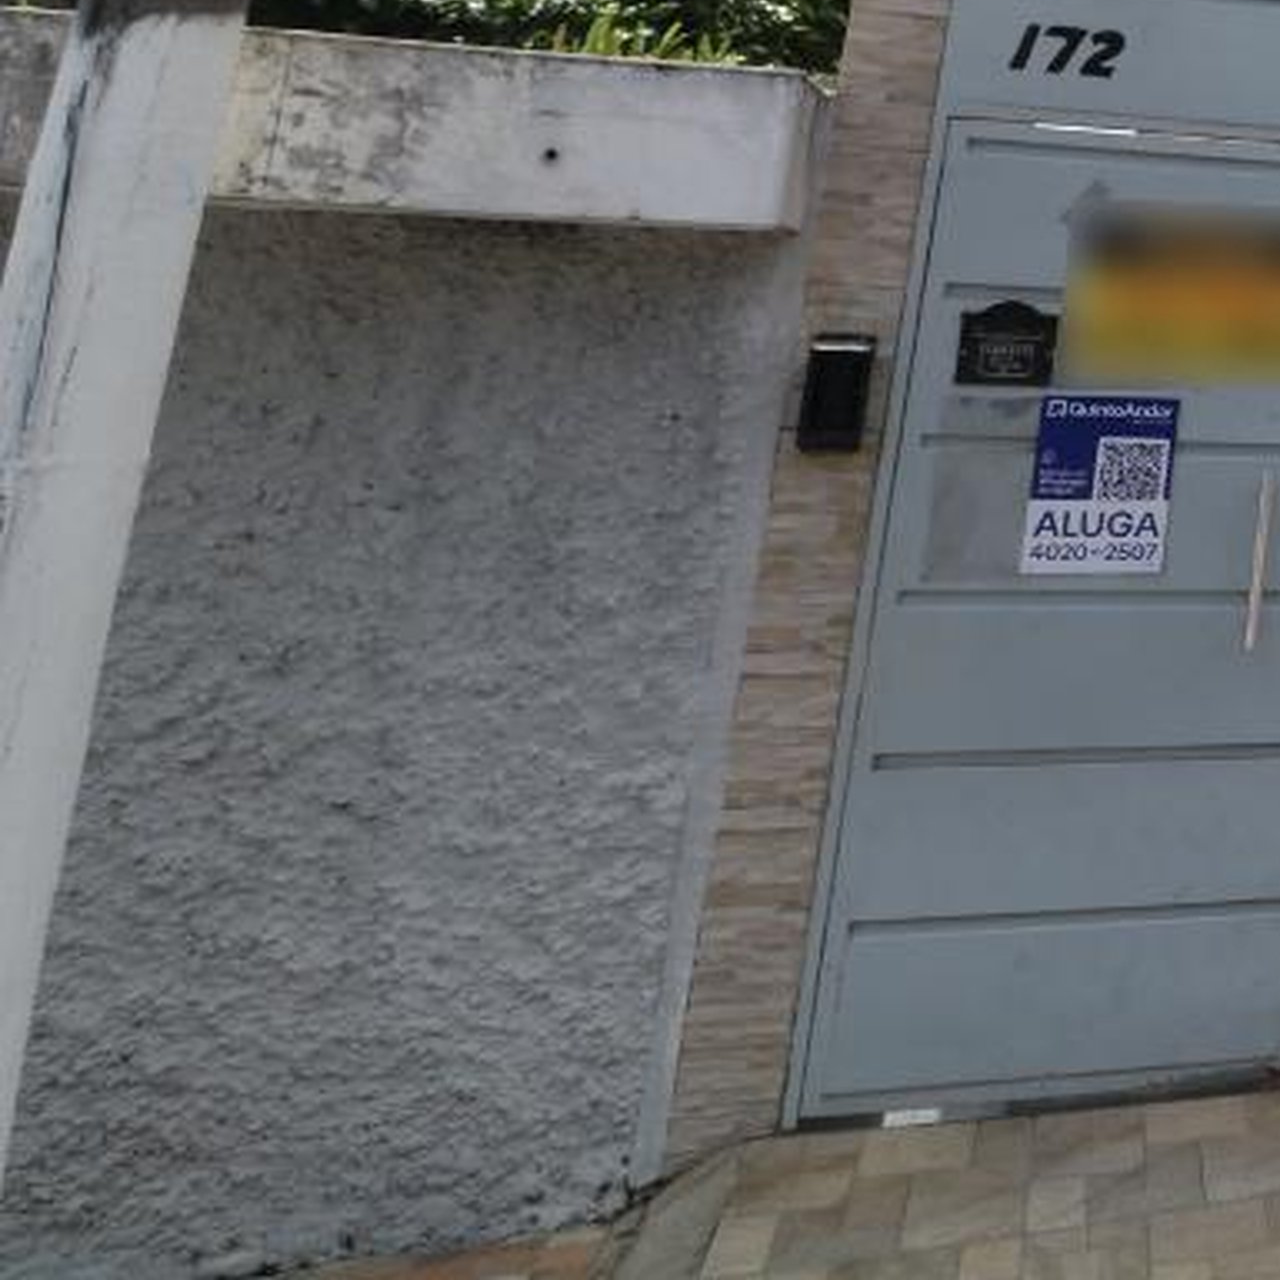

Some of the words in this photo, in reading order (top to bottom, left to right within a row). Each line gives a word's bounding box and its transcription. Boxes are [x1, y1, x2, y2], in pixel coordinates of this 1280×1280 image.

[1009, 23, 1126, 79] 172
[1033, 511, 1159, 538] ALUGA
[1029, 542, 1159, 561] 4020-2507
